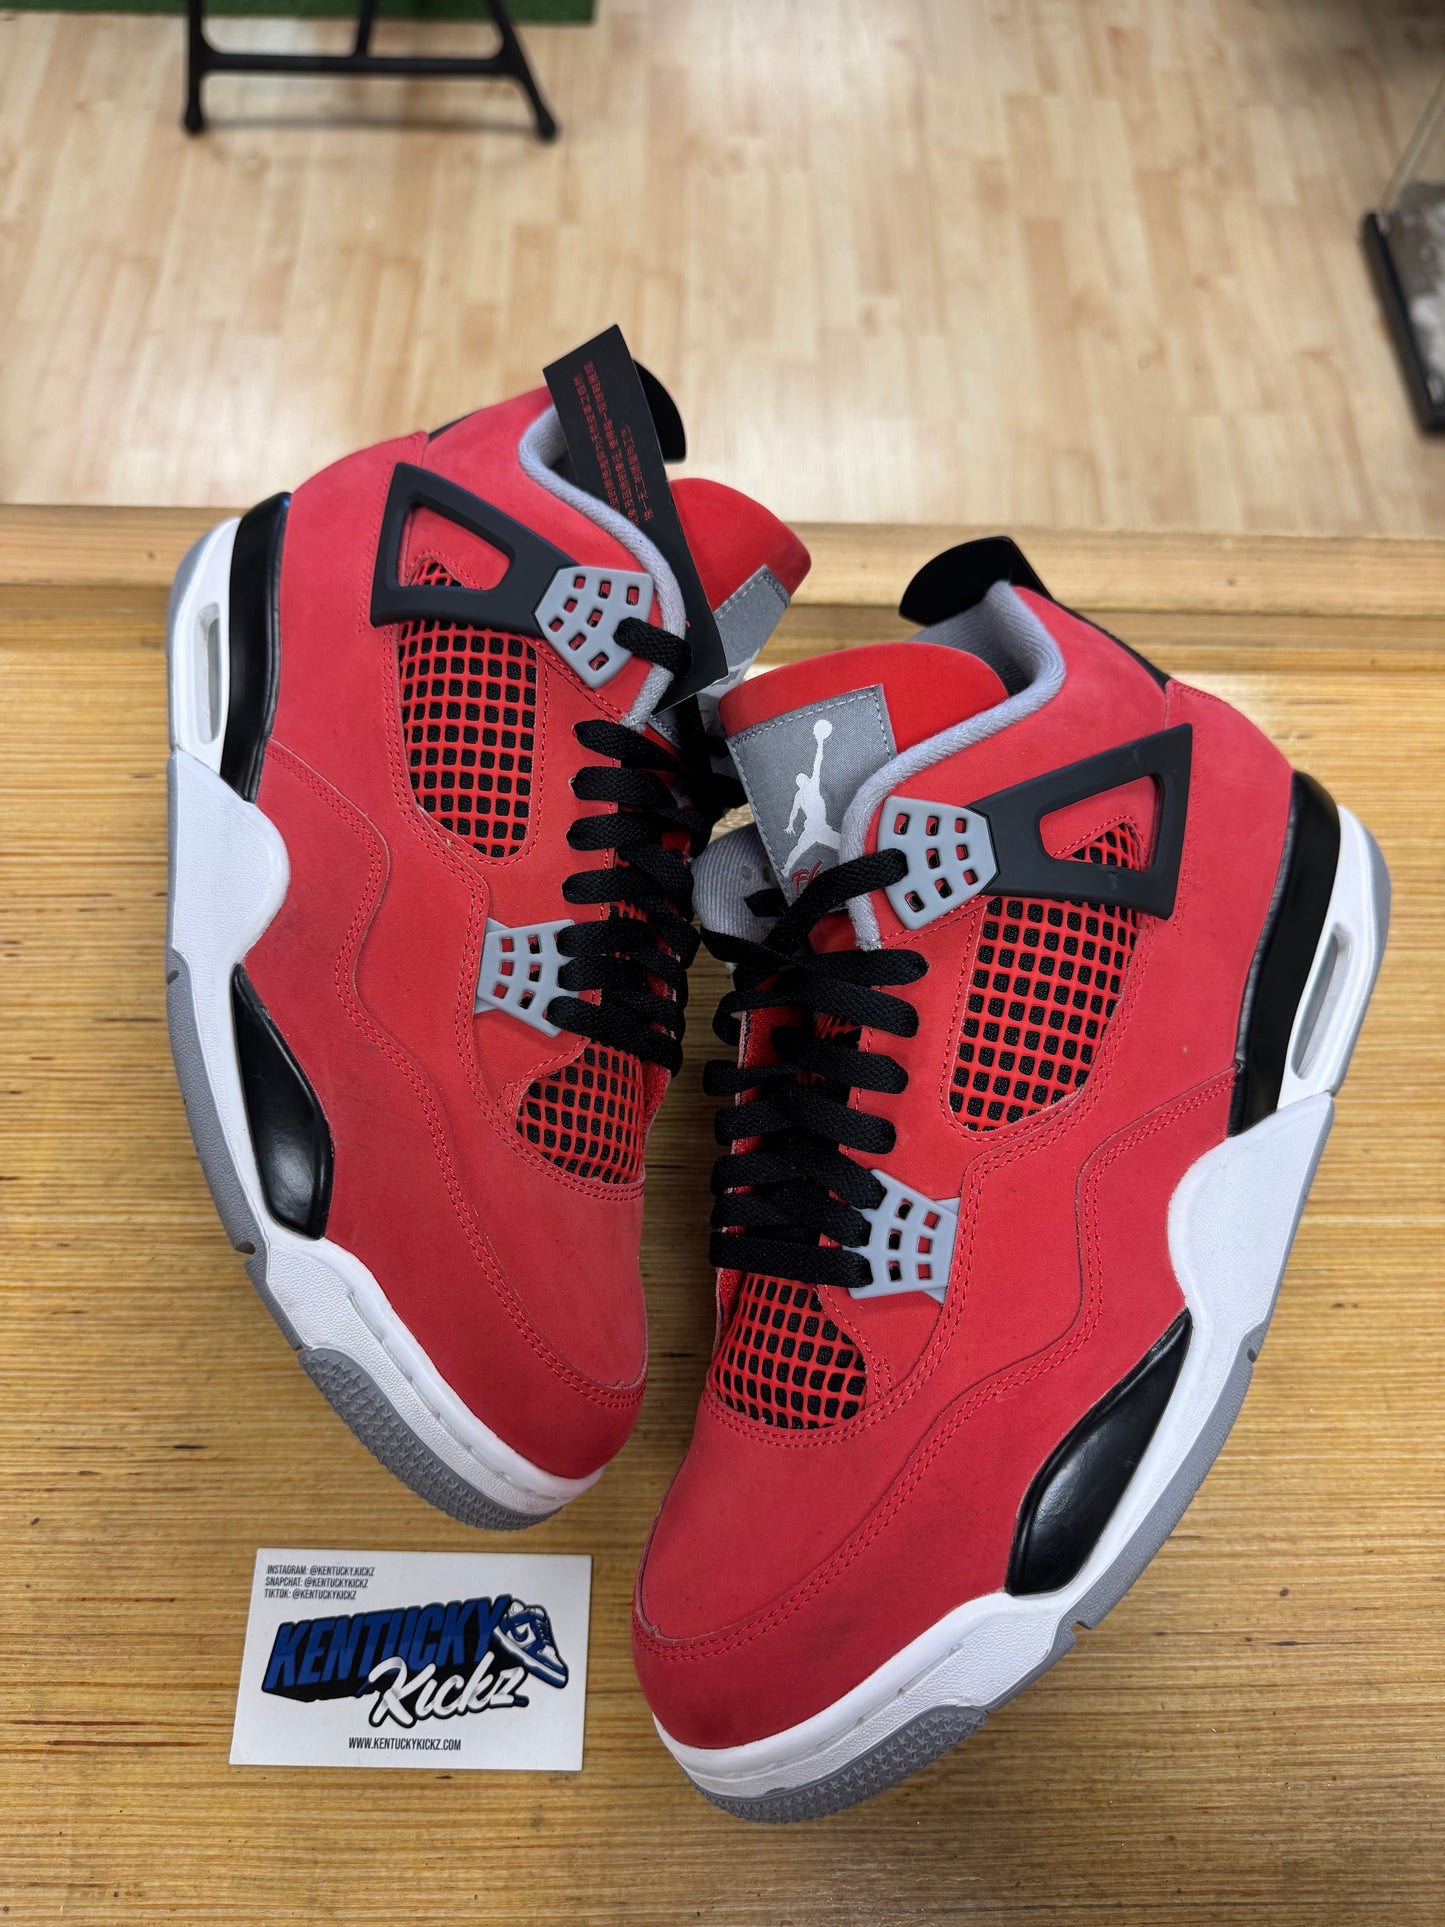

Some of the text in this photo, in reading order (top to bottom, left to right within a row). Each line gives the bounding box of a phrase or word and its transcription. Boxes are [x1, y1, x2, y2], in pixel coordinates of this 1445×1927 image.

[267, 1565, 376, 1576] INSTAGRAM: @KENTUCKY.KICKZ
[266, 1576, 368, 1588] SNAPCHAT: @KENTUCKYKICKZ
[264, 1588, 357, 1600] TIKTOK: @KENTUCKYKICKZ
[263, 1594, 512, 1691] KENTUCKY
[368, 1651, 524, 1727] Kickz
[348, 1737, 462, 1751] WWW.KENTUCKYKICKZ.COM
